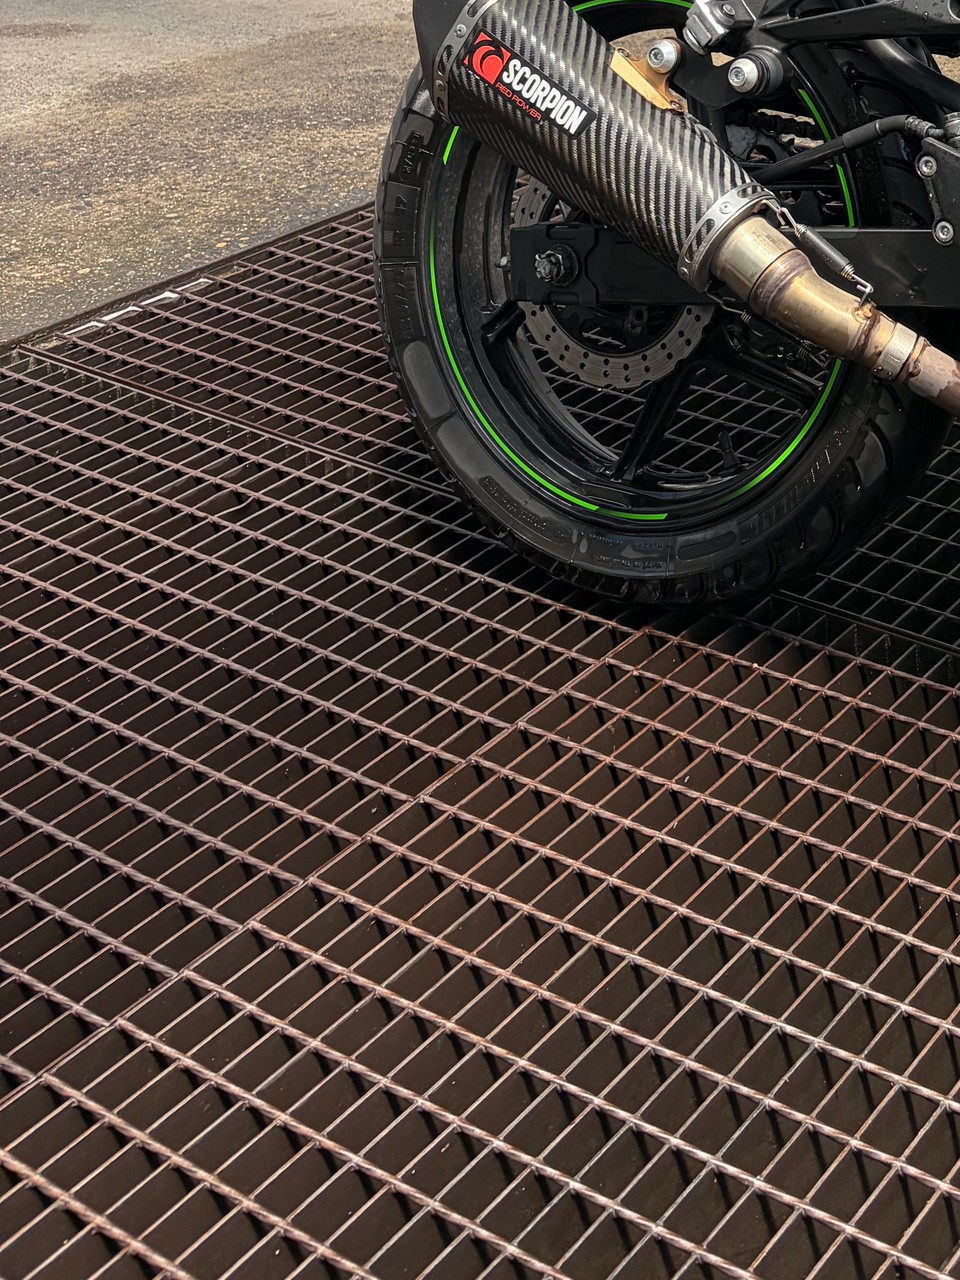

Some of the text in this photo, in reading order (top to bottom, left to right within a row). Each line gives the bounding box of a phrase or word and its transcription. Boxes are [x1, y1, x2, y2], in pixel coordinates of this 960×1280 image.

[496, 82, 542, 121] RED POWER
[502, 59, 588, 135] SCORPION
